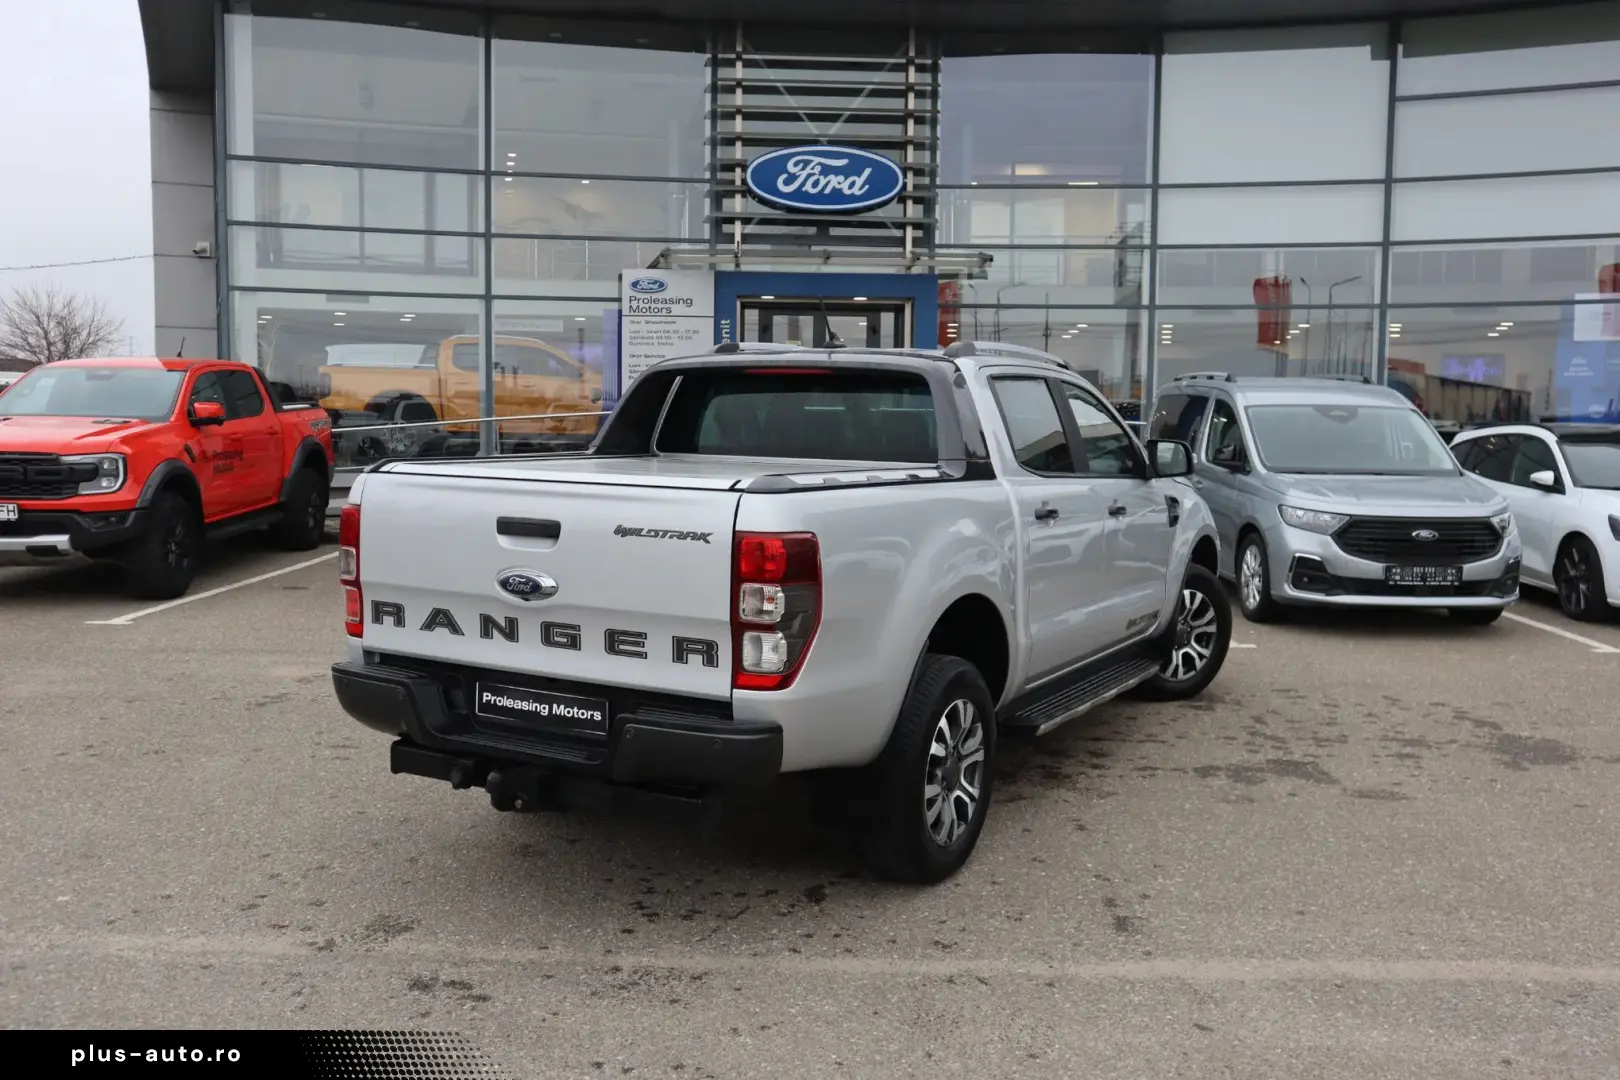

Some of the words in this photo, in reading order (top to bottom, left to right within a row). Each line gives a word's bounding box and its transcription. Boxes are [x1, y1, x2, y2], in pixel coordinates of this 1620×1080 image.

[776, 155, 872, 196] Ford
[637, 279, 660, 290] Ford
[629, 295, 693, 307] Proleasing
[629, 305, 672, 314] Motors
[614, 524, 713, 544] WILDTRAK
[507, 576, 533, 592] Ford
[371, 599, 719, 668] RANGER
[482, 691, 549, 716] Proleasing
[552, 702, 602, 721] Motors
